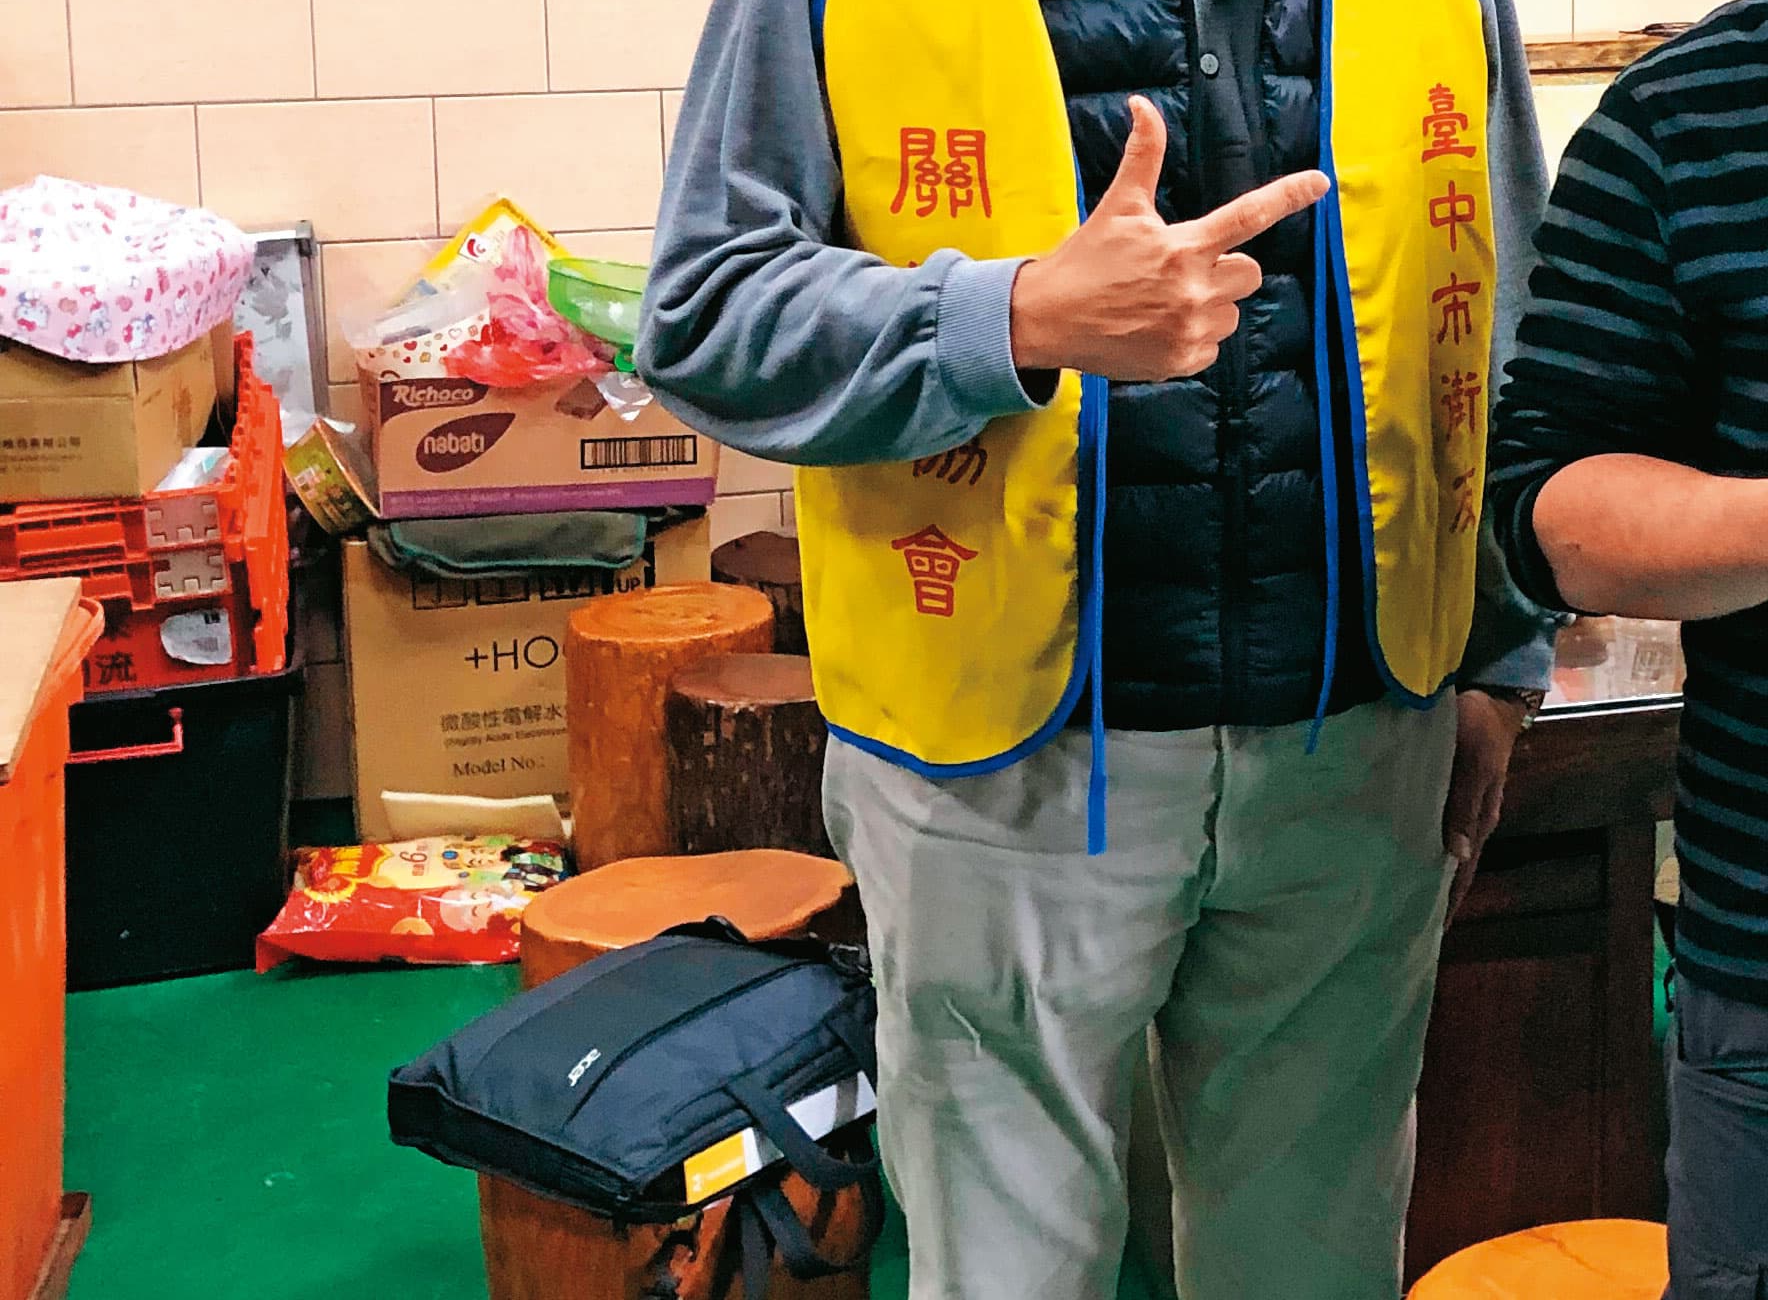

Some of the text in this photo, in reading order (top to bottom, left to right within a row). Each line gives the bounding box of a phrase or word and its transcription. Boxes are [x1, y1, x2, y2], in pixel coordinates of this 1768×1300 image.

[392, 384, 475, 407] Richoco
[424, 432, 485, 455] nabati
[617, 578, 641, 593] UP
[452, 759, 506, 778] Model
[568, 1048, 602, 1087] acer
